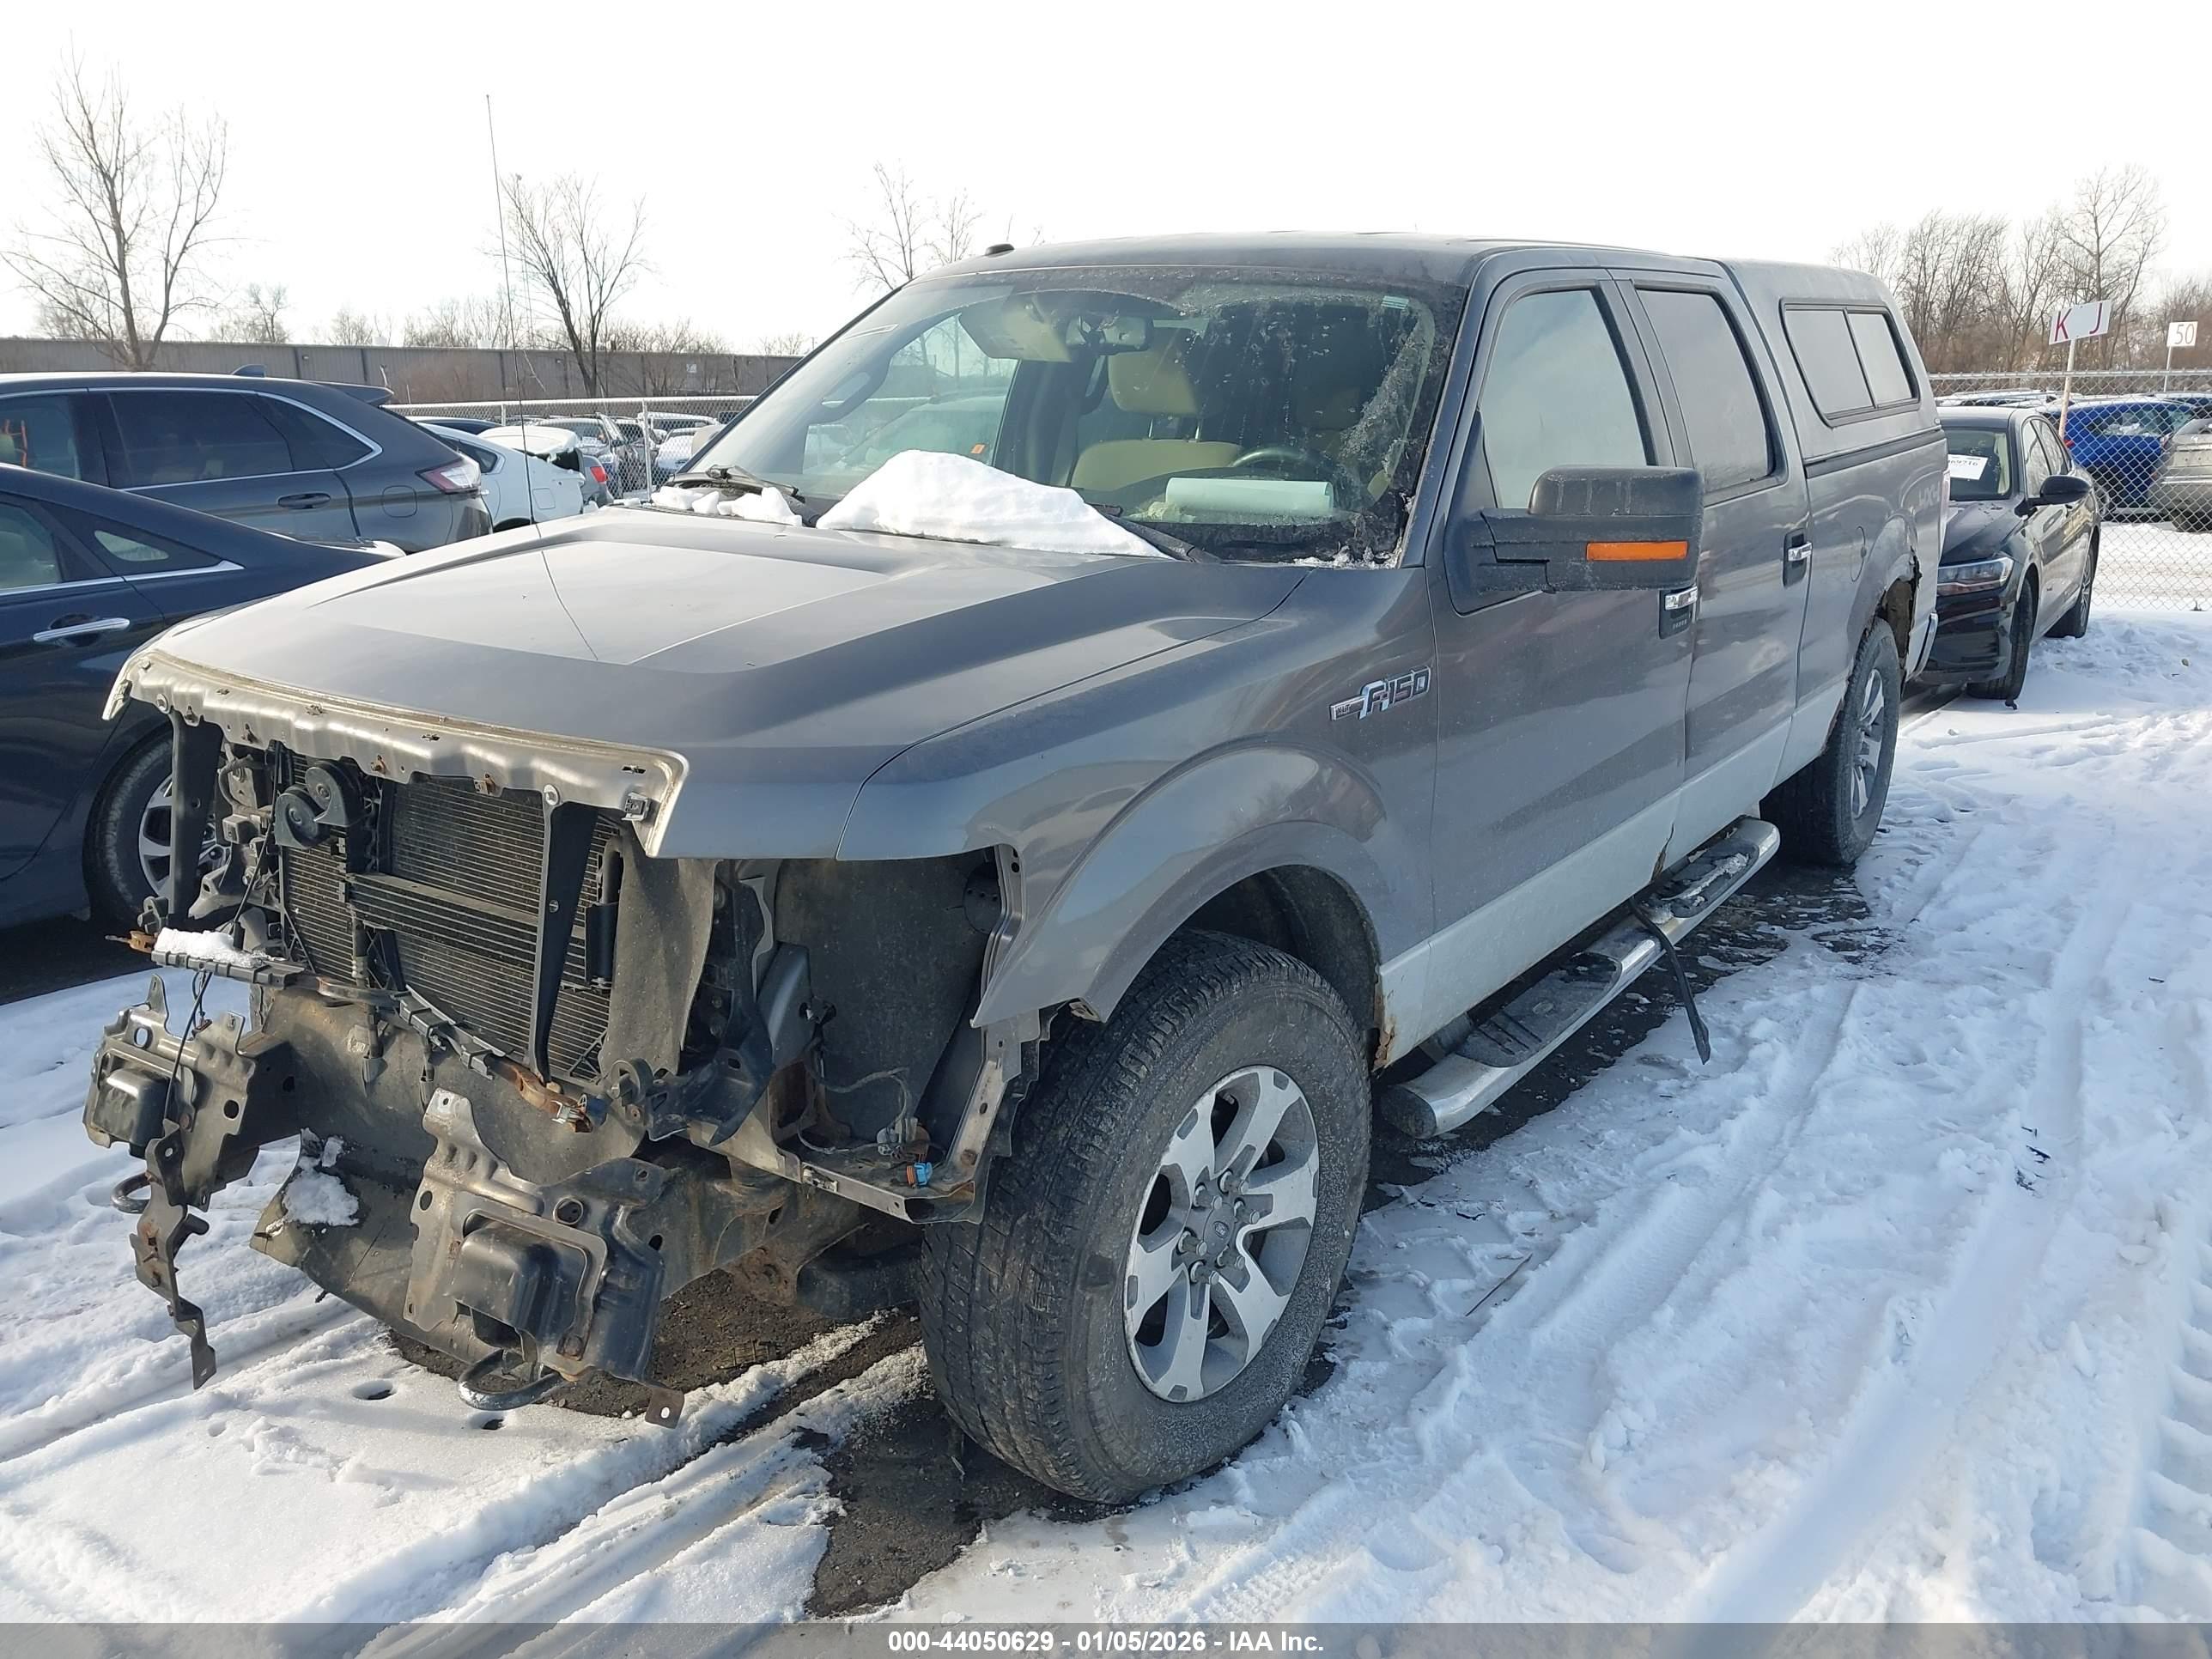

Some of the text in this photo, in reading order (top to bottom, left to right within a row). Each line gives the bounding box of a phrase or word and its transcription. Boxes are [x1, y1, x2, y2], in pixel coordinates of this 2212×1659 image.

[2054, 302, 2103, 342] K J
[2173, 323, 2195, 345] 50
